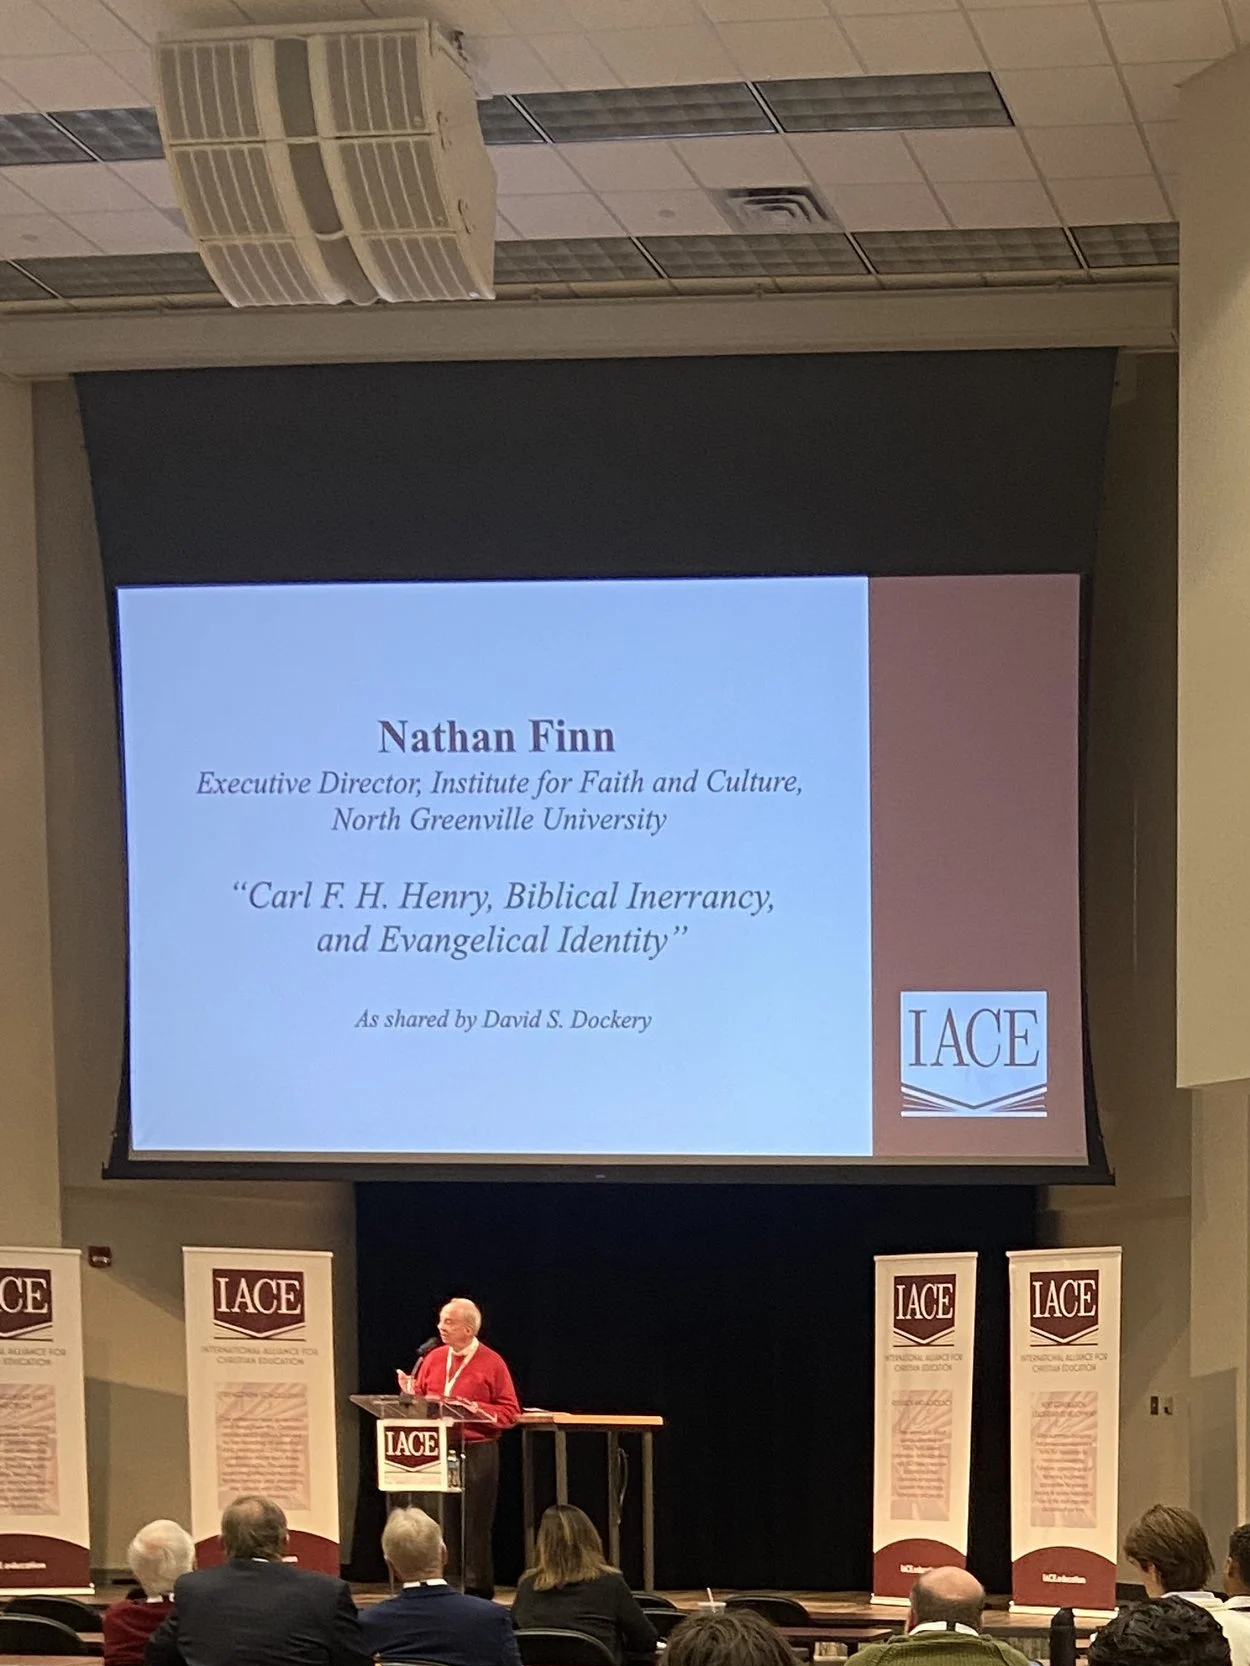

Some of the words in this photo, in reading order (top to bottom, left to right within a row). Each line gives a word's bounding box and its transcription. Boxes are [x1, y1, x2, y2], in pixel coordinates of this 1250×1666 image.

[376, 719, 516, 754] Nathan
[528, 718, 617, 754] Finn
[195, 770, 311, 797] Executive
[317, 770, 423, 800] Director,
[430, 770, 531, 795] Institute
[532, 769, 574, 801] for
[578, 769, 645, 796] Faith
[651, 768, 700, 795] and
[706, 768, 803, 798] Culture,
[330, 806, 402, 833] North
[409, 805, 535, 833] Greenville
[543, 806, 669, 838] University
[319, 881, 346, 911] F.
[354, 881, 389, 911] H.
[398, 881, 494, 919] Henry,
[502, 880, 619, 911] Biblical
[625, 881, 775, 919] Inerrancy,
[316, 923, 372, 954] and
[377, 924, 550, 962] Evangelical
[353, 1008, 380, 1030] As
[383, 1008, 450, 1031] shared
[454, 1008, 478, 1034] by
[480, 1008, 543, 1031] David
[545, 1008, 564, 1031] S.
[568, 1008, 653, 1035] Dockery
[908, 1007, 1040, 1068] IACE
[0, 1276, 48, 1314] CE
[215, 1277, 302, 1315] IACE
[896, 1283, 954, 1320] IACE
[1032, 1279, 1097, 1318] IACE
[385, 1430, 439, 1457] IACE
